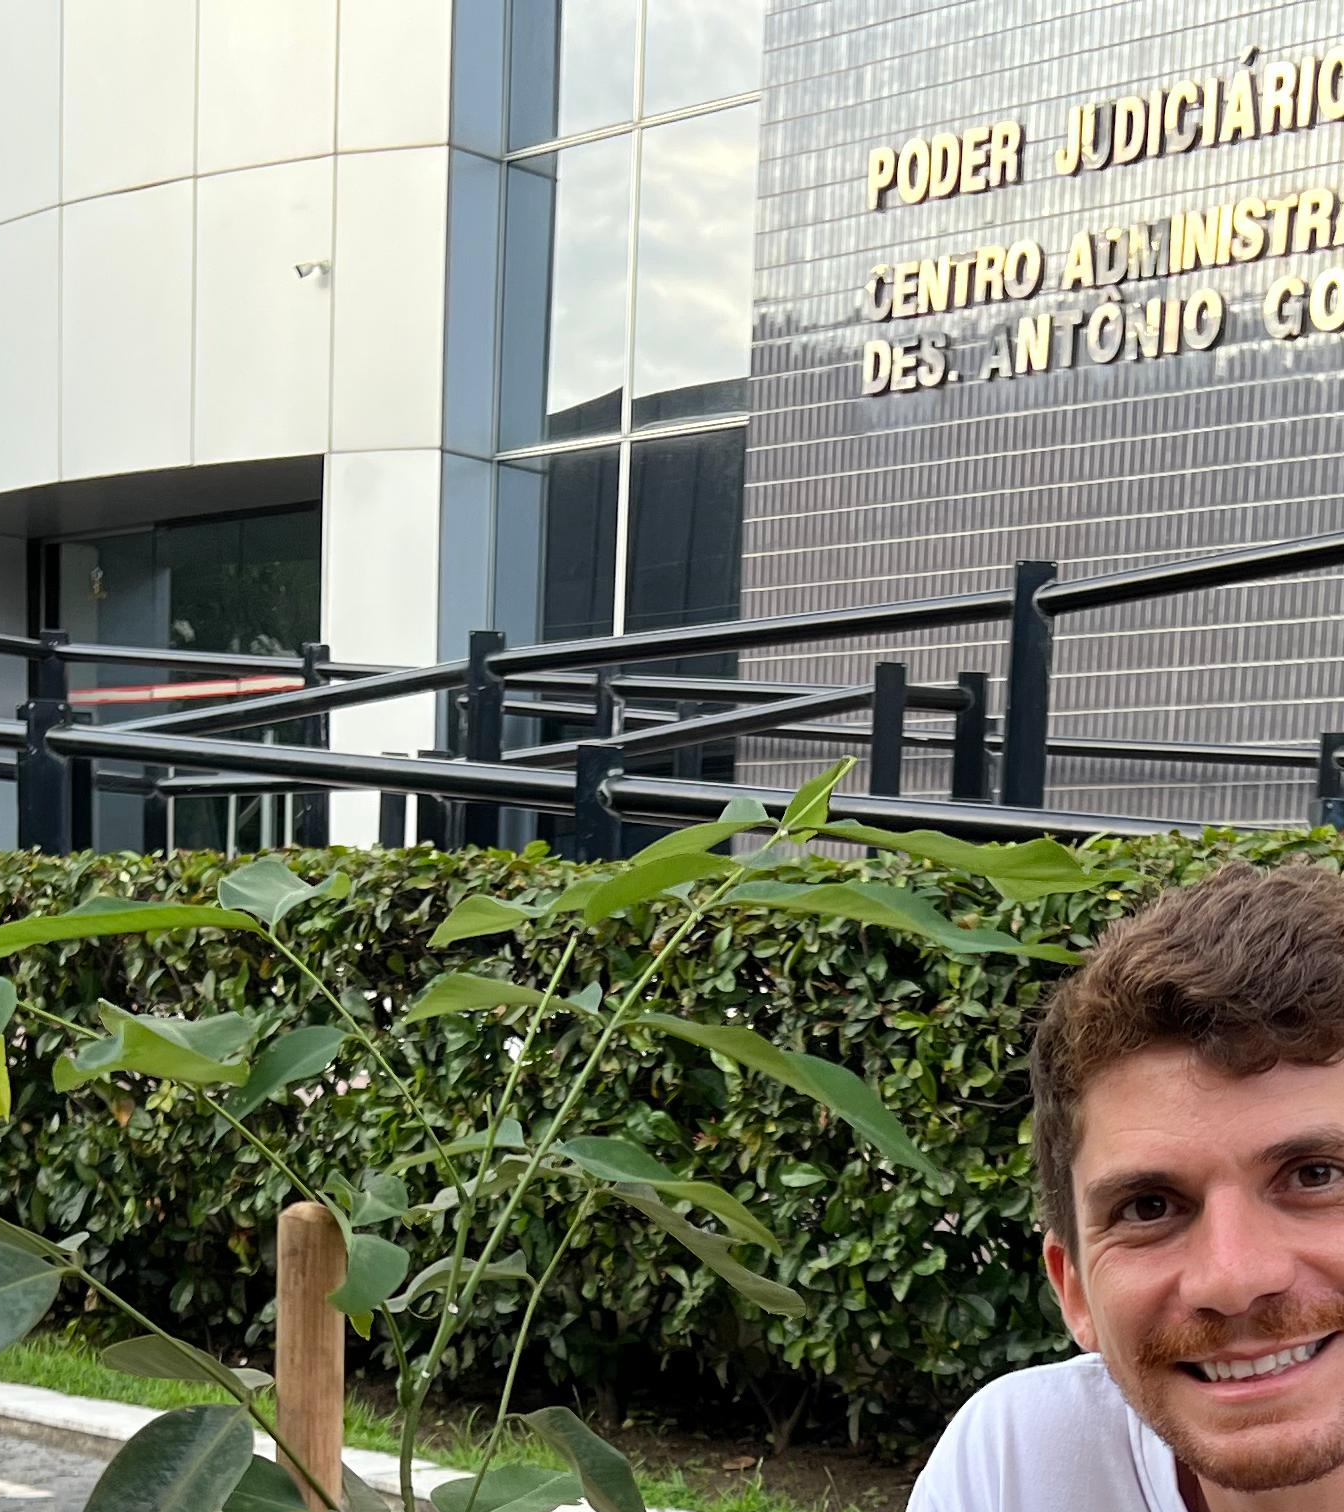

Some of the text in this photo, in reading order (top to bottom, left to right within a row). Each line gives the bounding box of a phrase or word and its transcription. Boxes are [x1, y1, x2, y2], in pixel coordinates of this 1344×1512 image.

[867, 120, 1022, 211] PODER
[864, 240, 1043, 321] CENTRO
[863, 331, 959, 396] DES.
[982, 288, 1225, 381] ANTÔNIO
